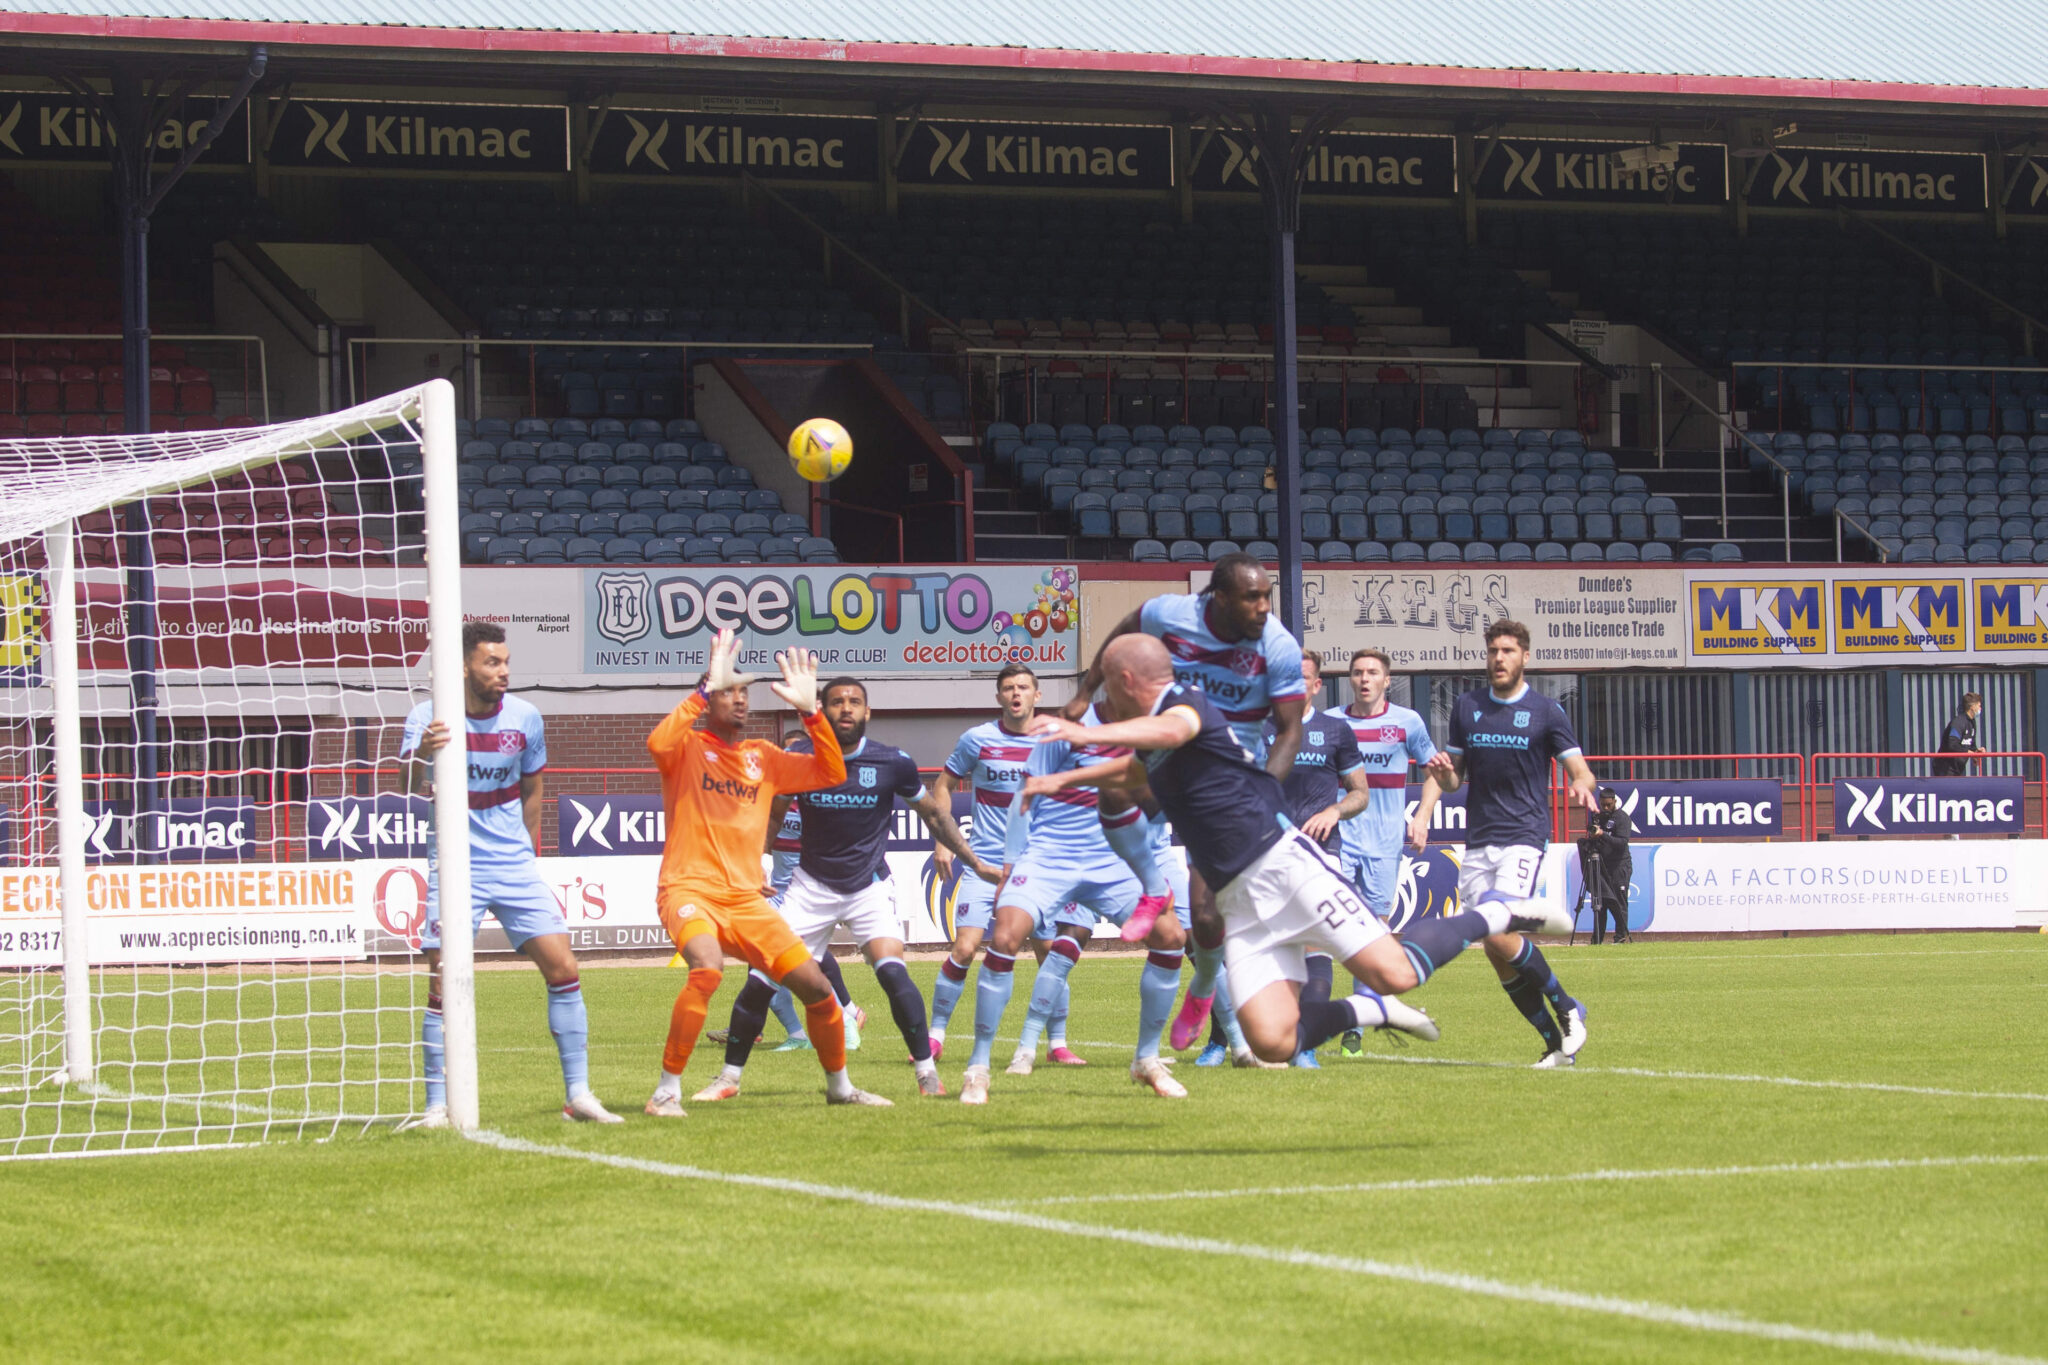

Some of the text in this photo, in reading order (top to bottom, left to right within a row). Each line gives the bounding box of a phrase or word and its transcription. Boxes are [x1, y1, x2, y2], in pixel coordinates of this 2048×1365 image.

[40, 106, 211, 150] Kilac
[365, 115, 531, 159] Kilmac
[686, 125, 844, 169] Kilmac
[986, 135, 1138, 177] Kilmac
[1292, 145, 1423, 185] ilmac
[1822, 168, 1956, 201] Kilmac
[1578, 576, 1632, 592] Dundee's
[1352, 574, 1510, 634] KEGS
[1535, 597, 1677, 615] Premier League Supplier
[1980, 584, 2048, 629] MK
[161, 620, 180, 634] to
[186, 620, 226, 635] over
[229, 617, 254, 634] 40
[259, 616, 382, 634] destinations
[388, 616, 430, 634] from
[462, 613, 570, 623] Aberdeen International
[537, 623, 570, 635] Airport
[1548, 620, 1665, 638] to the Licence Trade
[1698, 587, 1820, 653] MKM
[1840, 585, 1959, 651] MKM
[1703, 636, 1816, 649] BUILDING SUPPLIES
[1845, 634, 1956, 647] BUILDING SUPPLIES
[1984, 633, 2037, 645] BUILDING
[596, 651, 649, 665] INVEST
[655, 651, 669, 665] IN
[677, 651, 703, 665] THE
[738, 650, 767, 664] URE
[808, 650, 839, 663] OUR
[845, 650, 886, 663] CLUB!
[903, 640, 1066, 664] deelotto.co.uk
[1420, 646, 1448, 661] and
[1536, 649, 1561, 660] 01382
[1564, 648, 1594, 660] 815007
[1472, 733, 1529, 745] CROWN
[1361, 752, 1393, 767] way
[467, 763, 512, 782] tway
[986, 766, 1029, 781] bet
[702, 772, 759, 804] betway
[809, 793, 878, 804] CROWN
[1647, 795, 1772, 826] Kilmac
[1891, 793, 2014, 823] Kilmac
[121, 815, 246, 848] Klmac
[368, 813, 429, 844] Kil
[619, 811, 665, 842] Kil
[1517, 858, 1530, 880] 5
[1665, 868, 1718, 887] D&A
[1732, 867, 1850, 887] FACTORS
[1962, 866, 2009, 885] LTD
[140, 869, 353, 908] ENGINEERING
[1316, 889, 1360, 930] 26
[20, 931, 61, 951] 8317
[121, 925, 357, 951] www.acprecisioneng.co.uk
[569, 928, 673, 945] TEL DUND
